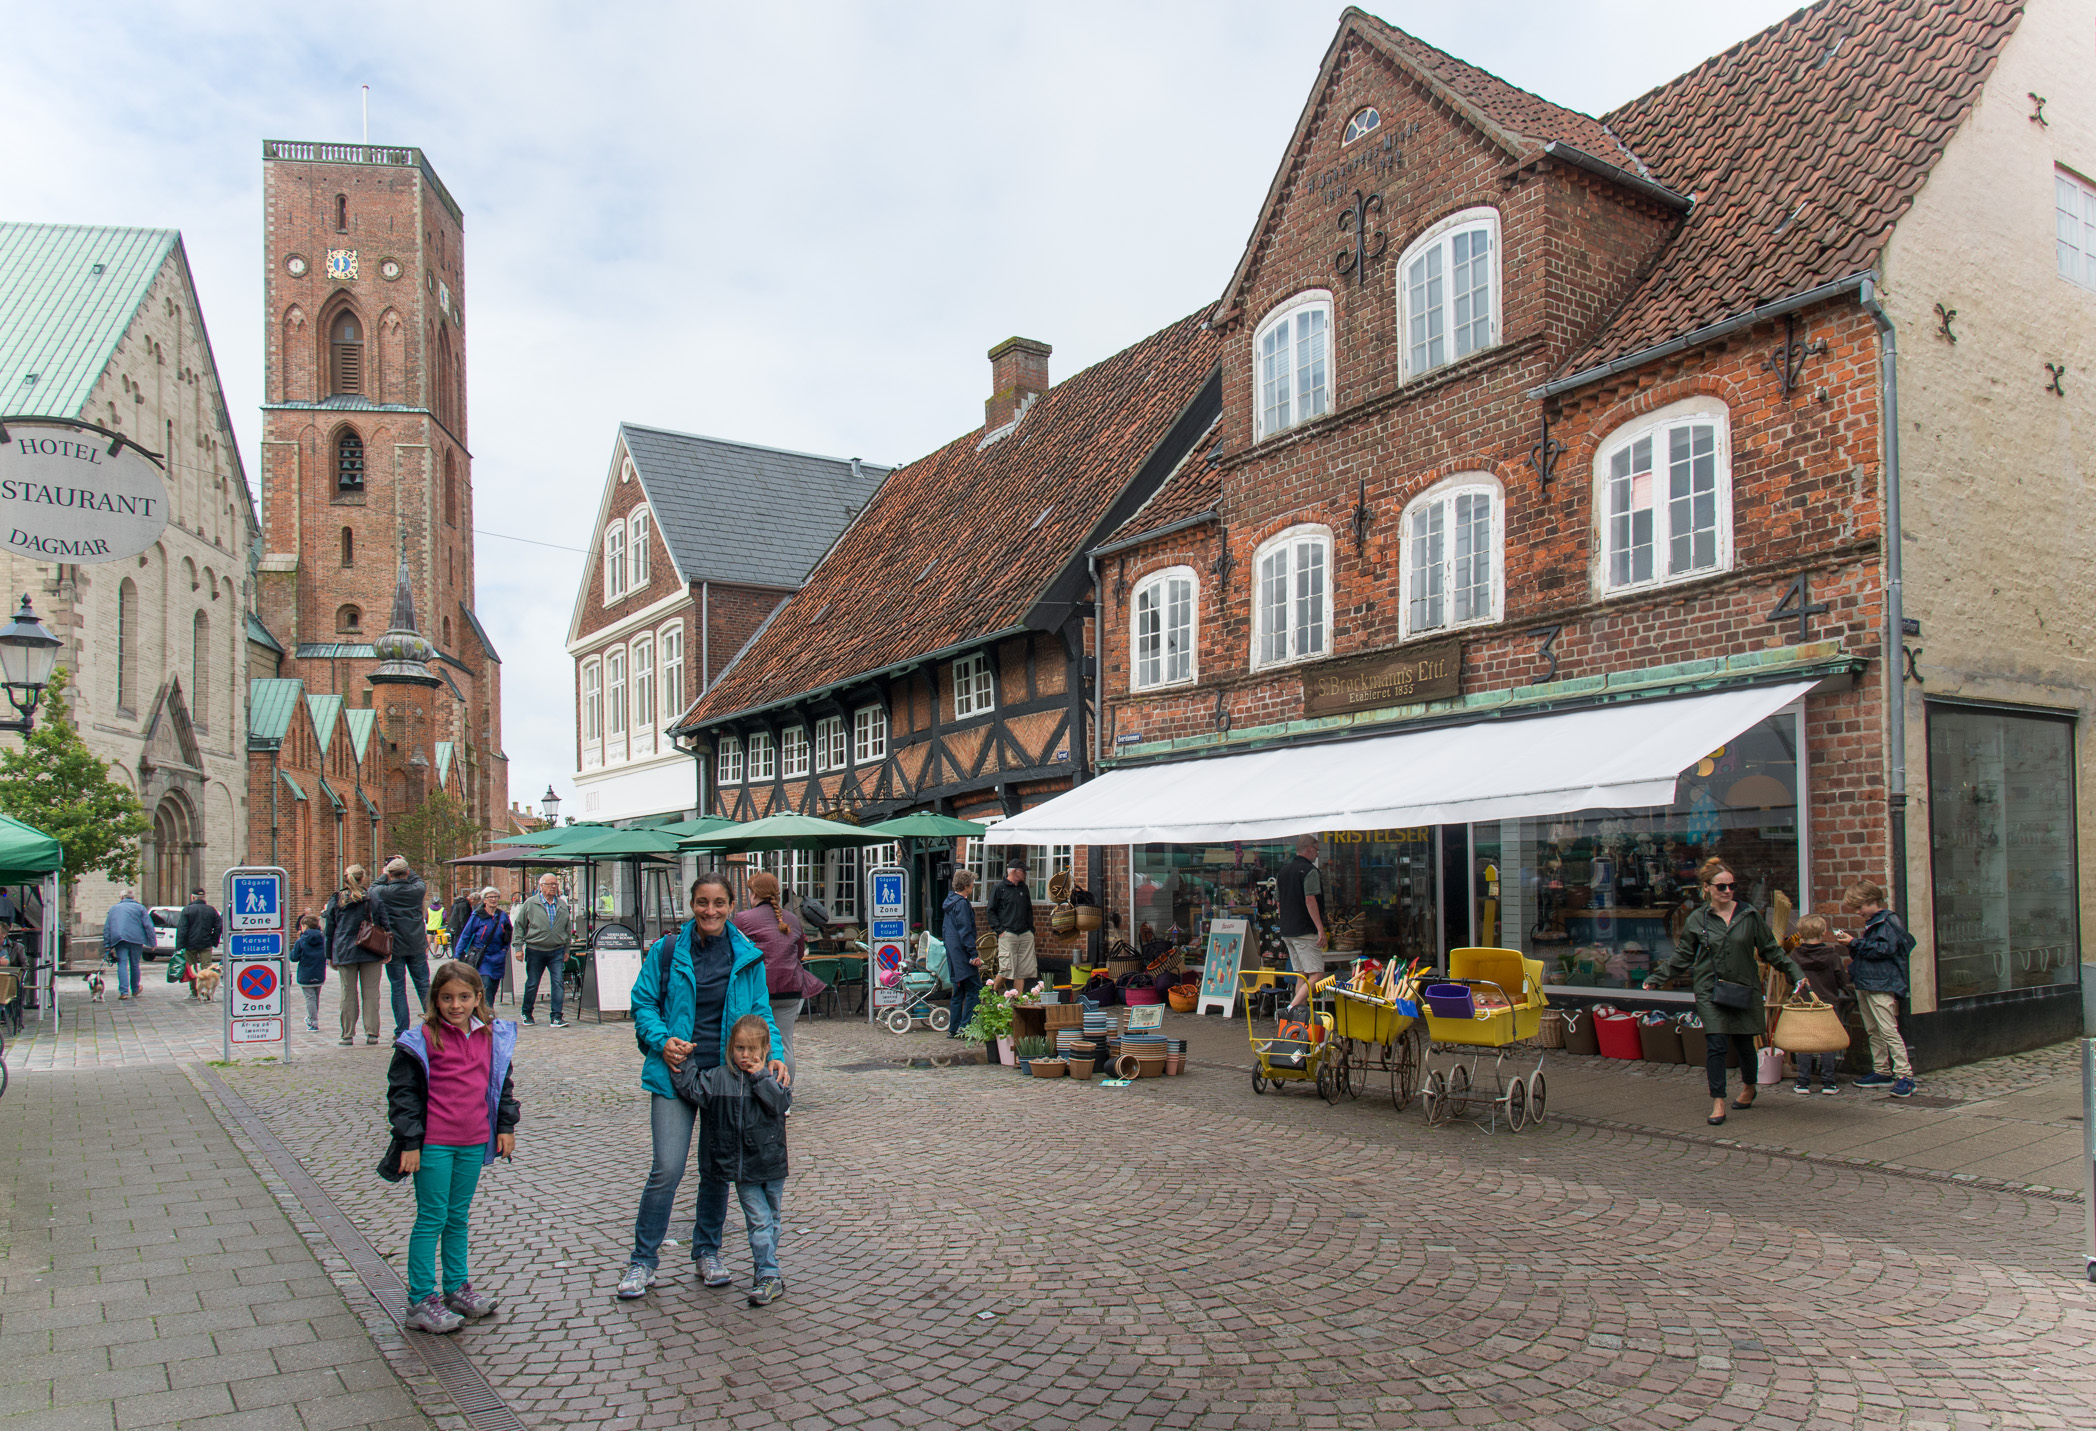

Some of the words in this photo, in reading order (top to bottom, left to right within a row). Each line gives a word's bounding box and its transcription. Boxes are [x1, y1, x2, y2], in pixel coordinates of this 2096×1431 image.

[1384, 122, 1419, 150] Minde
[1323, 182, 1347, 205] 1881
[1373, 149, 1401, 175] 1922
[18, 438, 102, 465] HOTEL
[1, 479, 157, 517] STAURANT
[8, 528, 111, 556] DAGMAR
[1349, 688, 1391, 703] Etableret
[1323, 826, 1429, 843] FRISTELSER
[242, 916, 271, 925] Zone
[242, 1003, 272, 1011] Zone
